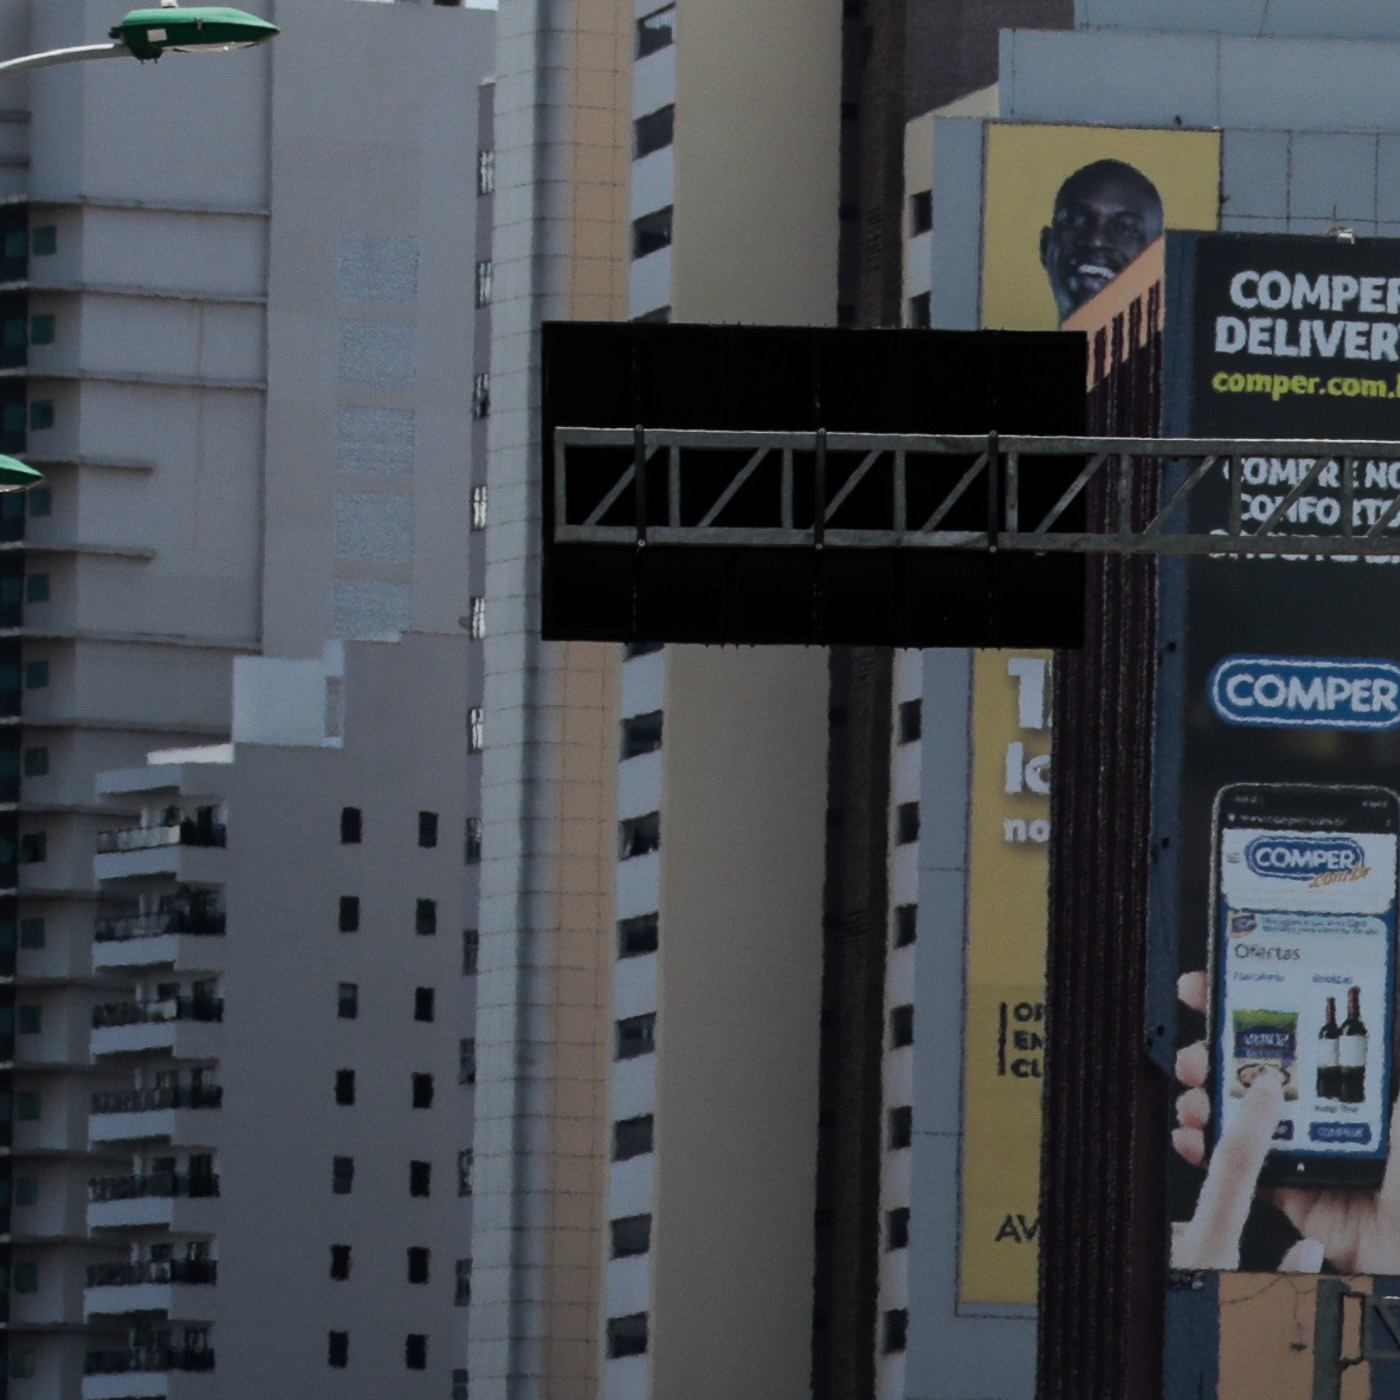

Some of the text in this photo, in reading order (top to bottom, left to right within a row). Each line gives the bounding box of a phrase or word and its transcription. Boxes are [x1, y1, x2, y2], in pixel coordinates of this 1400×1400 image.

[1226, 673, 1399, 712] COMPER
[1255, 847, 1355, 870] COMPER
[1234, 943, 1301, 961] Ofertas
